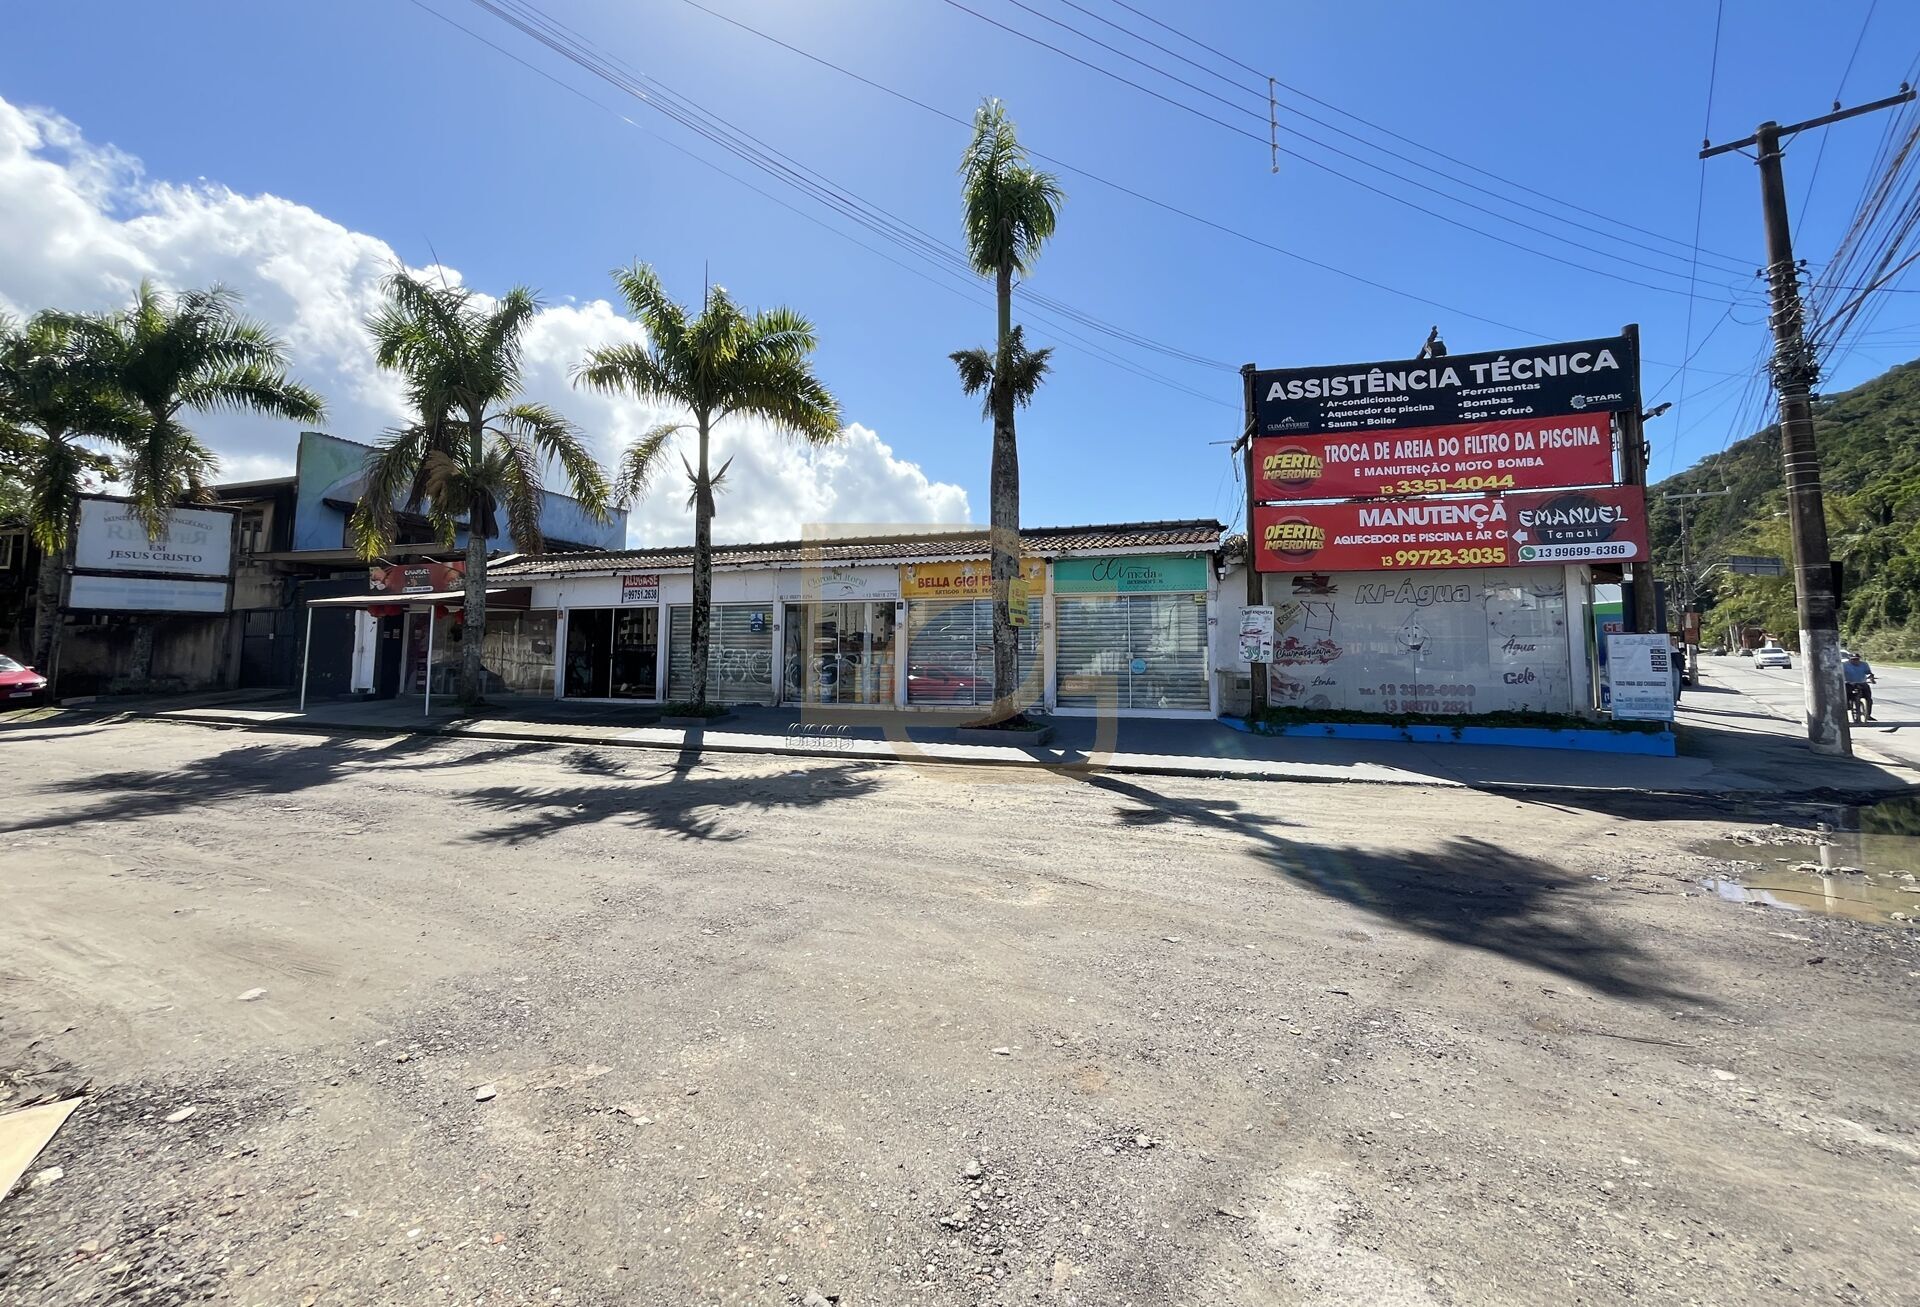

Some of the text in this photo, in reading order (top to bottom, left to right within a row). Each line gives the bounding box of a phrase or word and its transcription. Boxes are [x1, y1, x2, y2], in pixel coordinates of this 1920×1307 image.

[1266, 349, 1619, 401] ASSISTÊNCIA TÉCNICA
[1462, 383, 1540, 397] Ferramentas
[1327, 394, 1409, 408] Ar-condicionado
[1463, 396, 1514, 408] Bombas
[1586, 393, 1622, 402] STARK
[1327, 404, 1435, 418] Aquecedor de piscina
[1464, 411, 1488, 420] Spa
[1499, 405, 1534, 415] ofurô
[1327, 420, 1358, 428] Sauna
[1324, 425, 1600, 463] TROCA DE AREIA DO FILTRO DA PISCINA
[1262, 453, 1323, 470] OFERTAS
[1354, 456, 1544, 477] E MANUTENÇÃO MOTO BOMBA
[1380, 474, 1515, 494] 13 3351-4044
[1518, 505, 1629, 527] EMANUEL
[1264, 524, 1326, 541] OFERTAS
[1334, 533, 1399, 545] AQUECEDOR
[1403, 533, 1416, 543] DE
[1419, 531, 1463, 543] PISCINA
[1466, 531, 1473, 541] E
[1475, 530, 1492, 540] AR
[1547, 528, 1599, 539] Temaki
[149, 544, 166, 552] EM
[1538, 545, 1625, 557] 13 99699-6386
[107, 549, 203, 563] JESUS CRISTO
[1381, 547, 1505, 566] 13 99723-3035
[917, 576, 950, 589] BELLA
[953, 575, 979, 587] GIGI
[1502, 635, 1536, 655] Água
[1504, 667, 1536, 685] Gelo
[1379, 683, 1396, 696] 13
